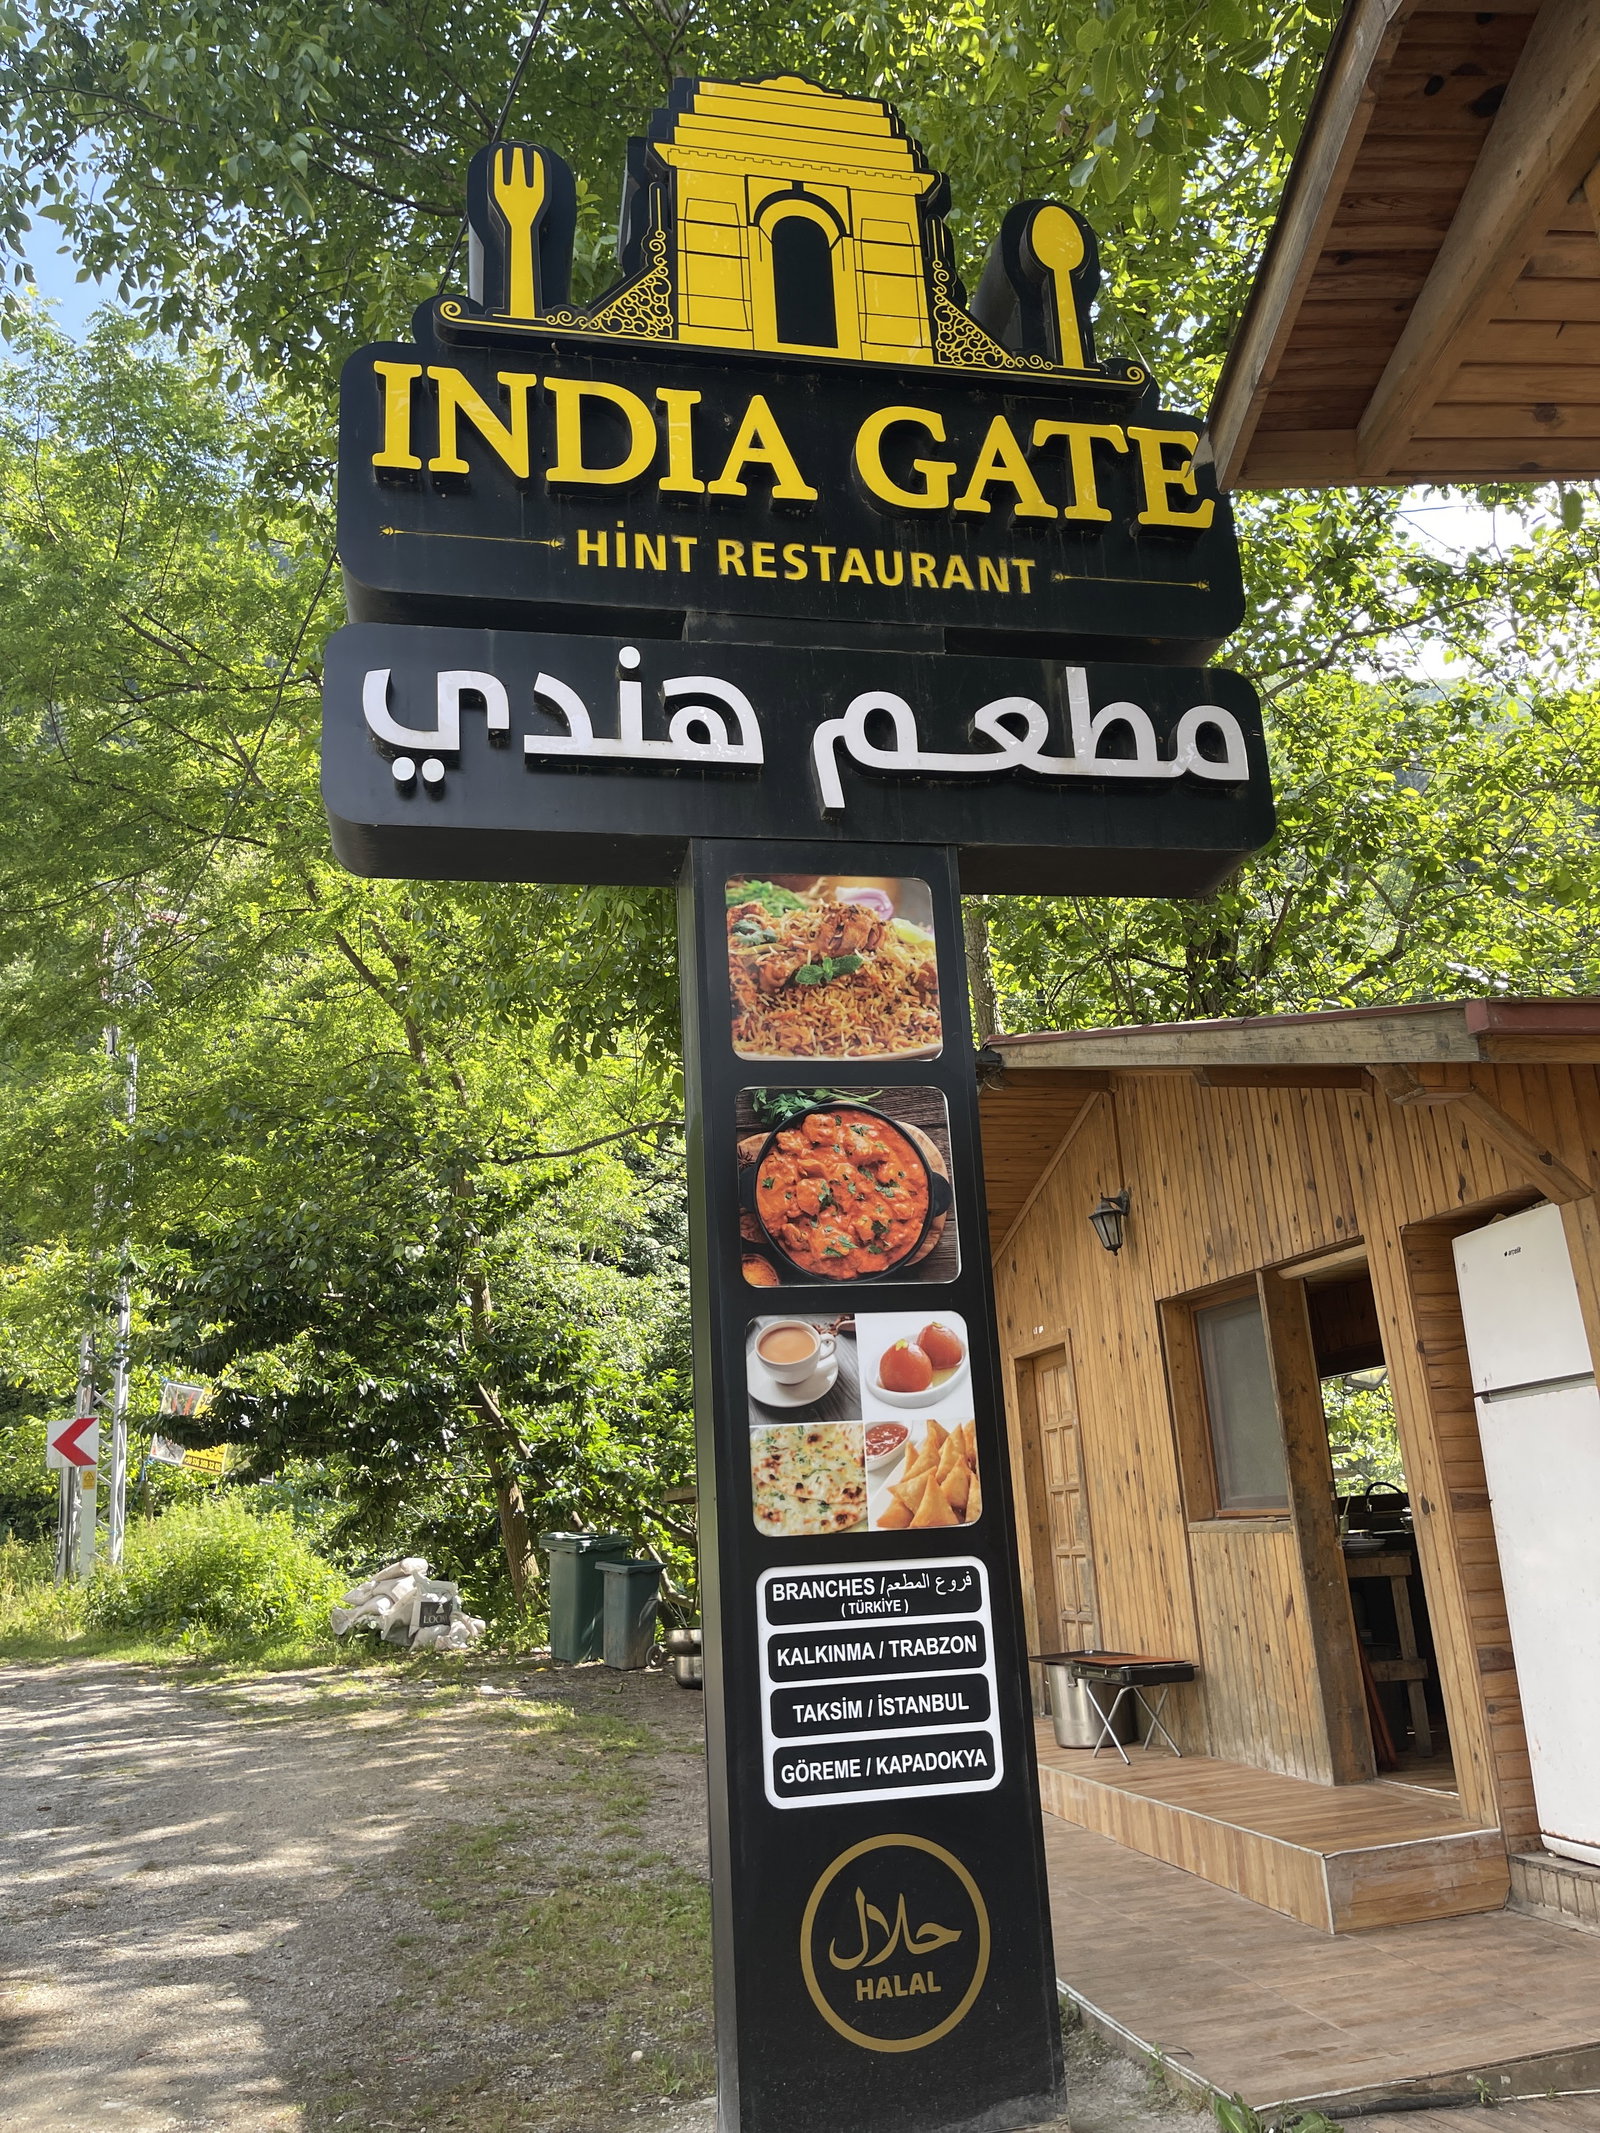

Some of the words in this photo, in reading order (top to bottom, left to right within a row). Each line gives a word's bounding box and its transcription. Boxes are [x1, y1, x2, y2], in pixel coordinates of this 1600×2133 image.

[371, 360, 819, 501] INDIA
[855, 405, 1215, 529] GATE
[577, 520, 698, 573] HİNT
[717, 538, 1035, 593] RESTAURANT
[362, 645, 765, 783] هندي
[812, 666, 1250, 809] مطعم
[772, 1577, 876, 1602] BRANCHES
[886, 1572, 930, 1598] المطعم
[934, 1570, 972, 1596] فروع
[777, 1641, 876, 1667] KALKINMA
[888, 1634, 977, 1658] TRABZON
[792, 1696, 863, 1723] TAKSİM
[877, 1692, 970, 1717] İSTANBUL
[781, 1758, 862, 1784] GÖREME
[876, 1748, 988, 1776] KAPADOKYA
[828, 1886, 963, 1971] حلال
[855, 1970, 942, 2002] HALAL
